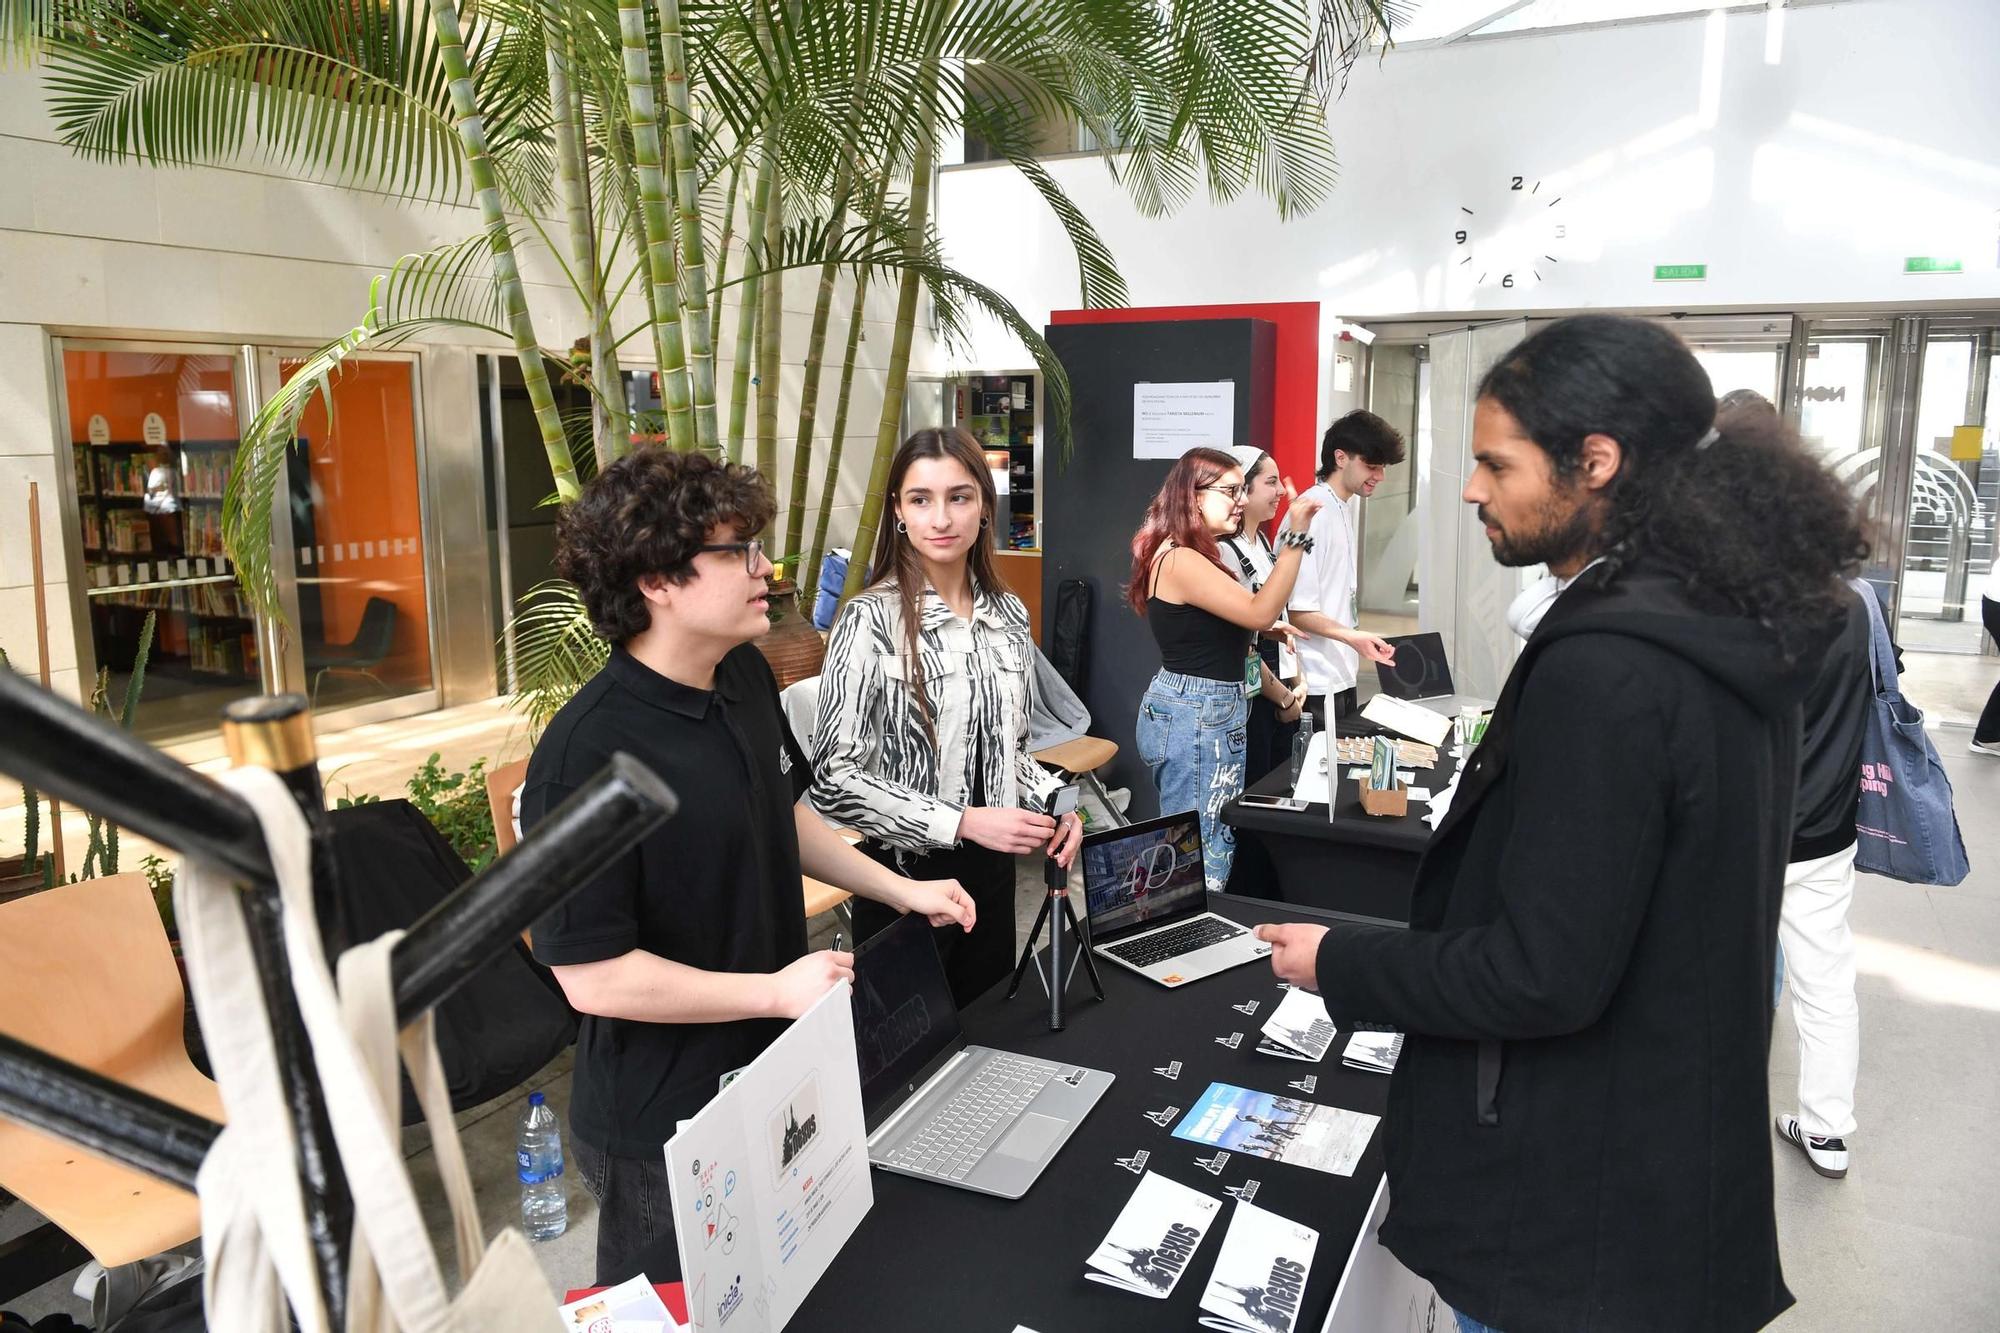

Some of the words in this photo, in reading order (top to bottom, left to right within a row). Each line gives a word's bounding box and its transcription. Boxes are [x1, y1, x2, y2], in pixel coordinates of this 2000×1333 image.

[1455, 230, 1467, 245] 9
[1555, 225, 1566, 239] 3
[1661, 267, 1697, 277] SALIDA
[1502, 274, 1514, 288] 6
[1150, 1222, 1201, 1274] NEXUS
[1261, 1256, 1306, 1314] NEXUS
[717, 1285, 740, 1318] inicia
